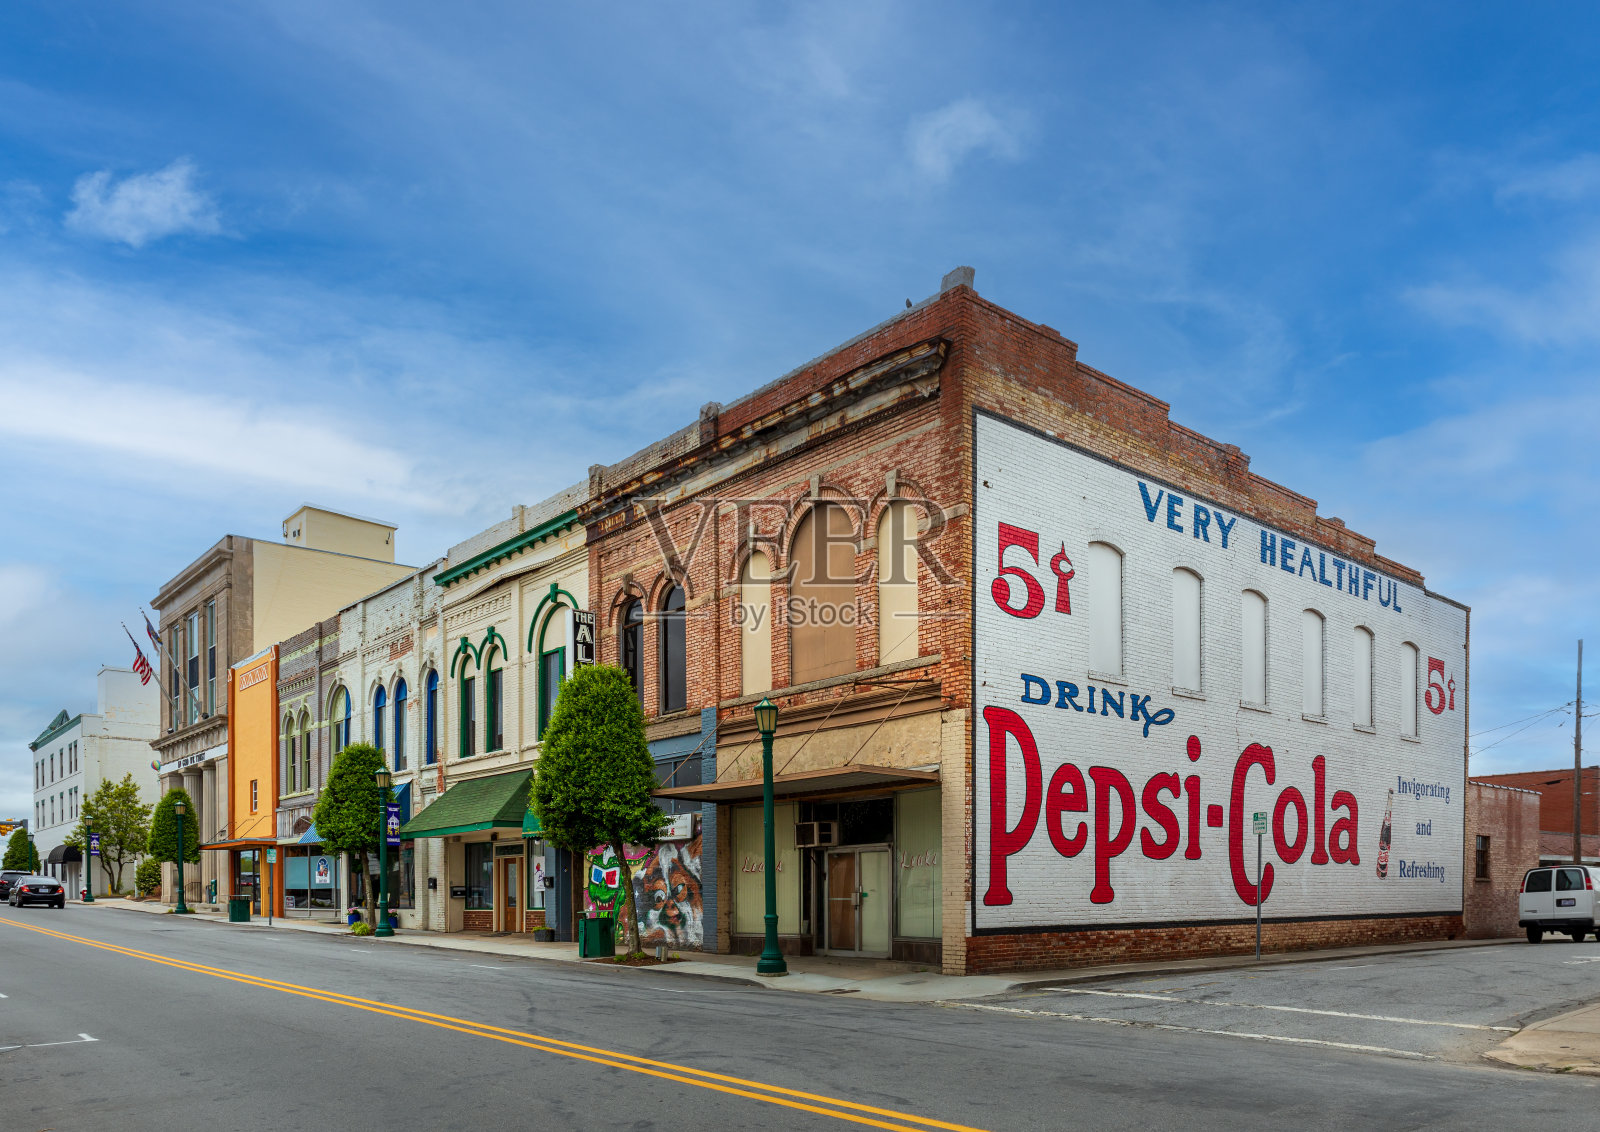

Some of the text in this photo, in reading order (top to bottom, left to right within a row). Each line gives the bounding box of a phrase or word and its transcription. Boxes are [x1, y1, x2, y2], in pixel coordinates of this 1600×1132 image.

[1137, 481, 1403, 614] VERY HEALTHFUL
[574, 611, 594, 625] THE
[576, 624, 593, 666] AL
[1021, 672, 1176, 740] DRINK
[983, 705, 1360, 907] Pepsi-Cola
[1397, 776, 1451, 804] Invigorating
[1415, 820, 1432, 836] and
[1399, 860, 1445, 883] Refreshing
